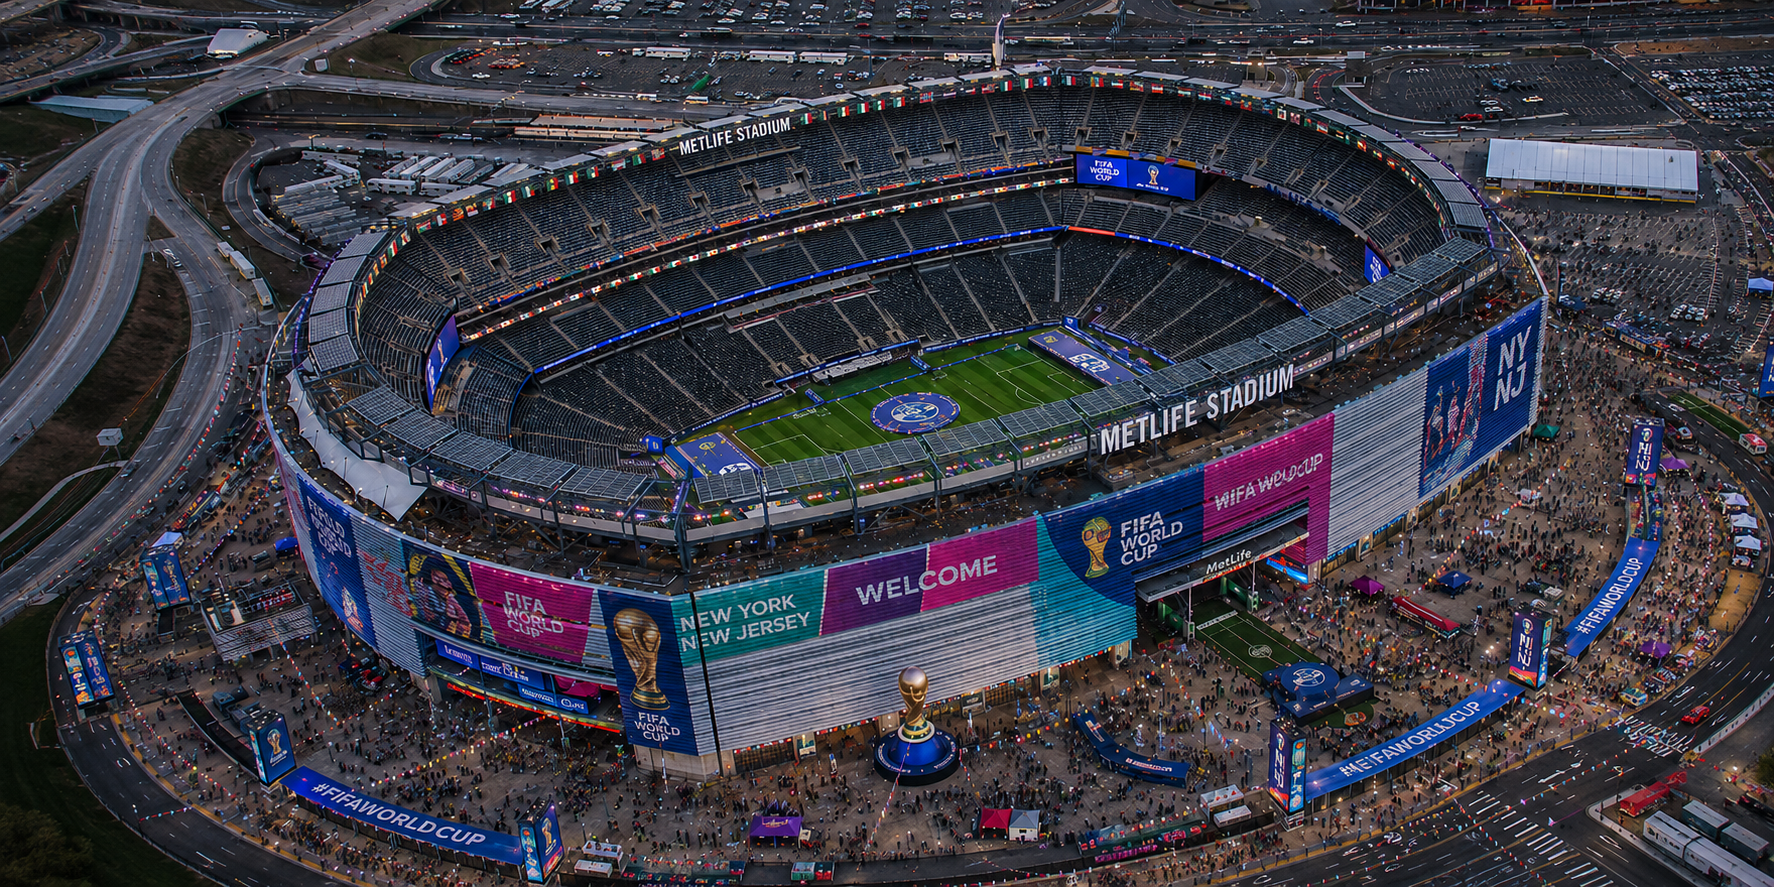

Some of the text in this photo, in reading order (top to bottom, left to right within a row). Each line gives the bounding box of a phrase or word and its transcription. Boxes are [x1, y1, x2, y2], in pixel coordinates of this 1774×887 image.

[679, 117, 791, 155] METLIFE STADIUM
[1095, 160, 1113, 168] FIFA
[1498, 325, 1532, 376] NY
[1493, 361, 1527, 411] NJ
[1100, 364, 1294, 455] METLIFE STADIUM
[1120, 521, 1183, 552] WORLD
[1121, 511, 1164, 538] FIFA
[1120, 543, 1158, 566] CUP
[1206, 549, 1252, 574] MetLife
[855, 555, 998, 605] WELCOME
[504, 591, 547, 615] FIFA
[1574, 557, 1643, 635] #FIFAWORLDCUP
[502, 603, 564, 634] WORLD
[507, 619, 541, 638] CUP
[680, 594, 797, 632] NEW YORK
[681, 611, 810, 652] NEW JERSEY
[633, 720, 680, 736] WORLD
[638, 711, 670, 726] FIFA
[643, 731, 669, 742] CUP
[311, 783, 486, 846] #FIFAWORLDCUP
